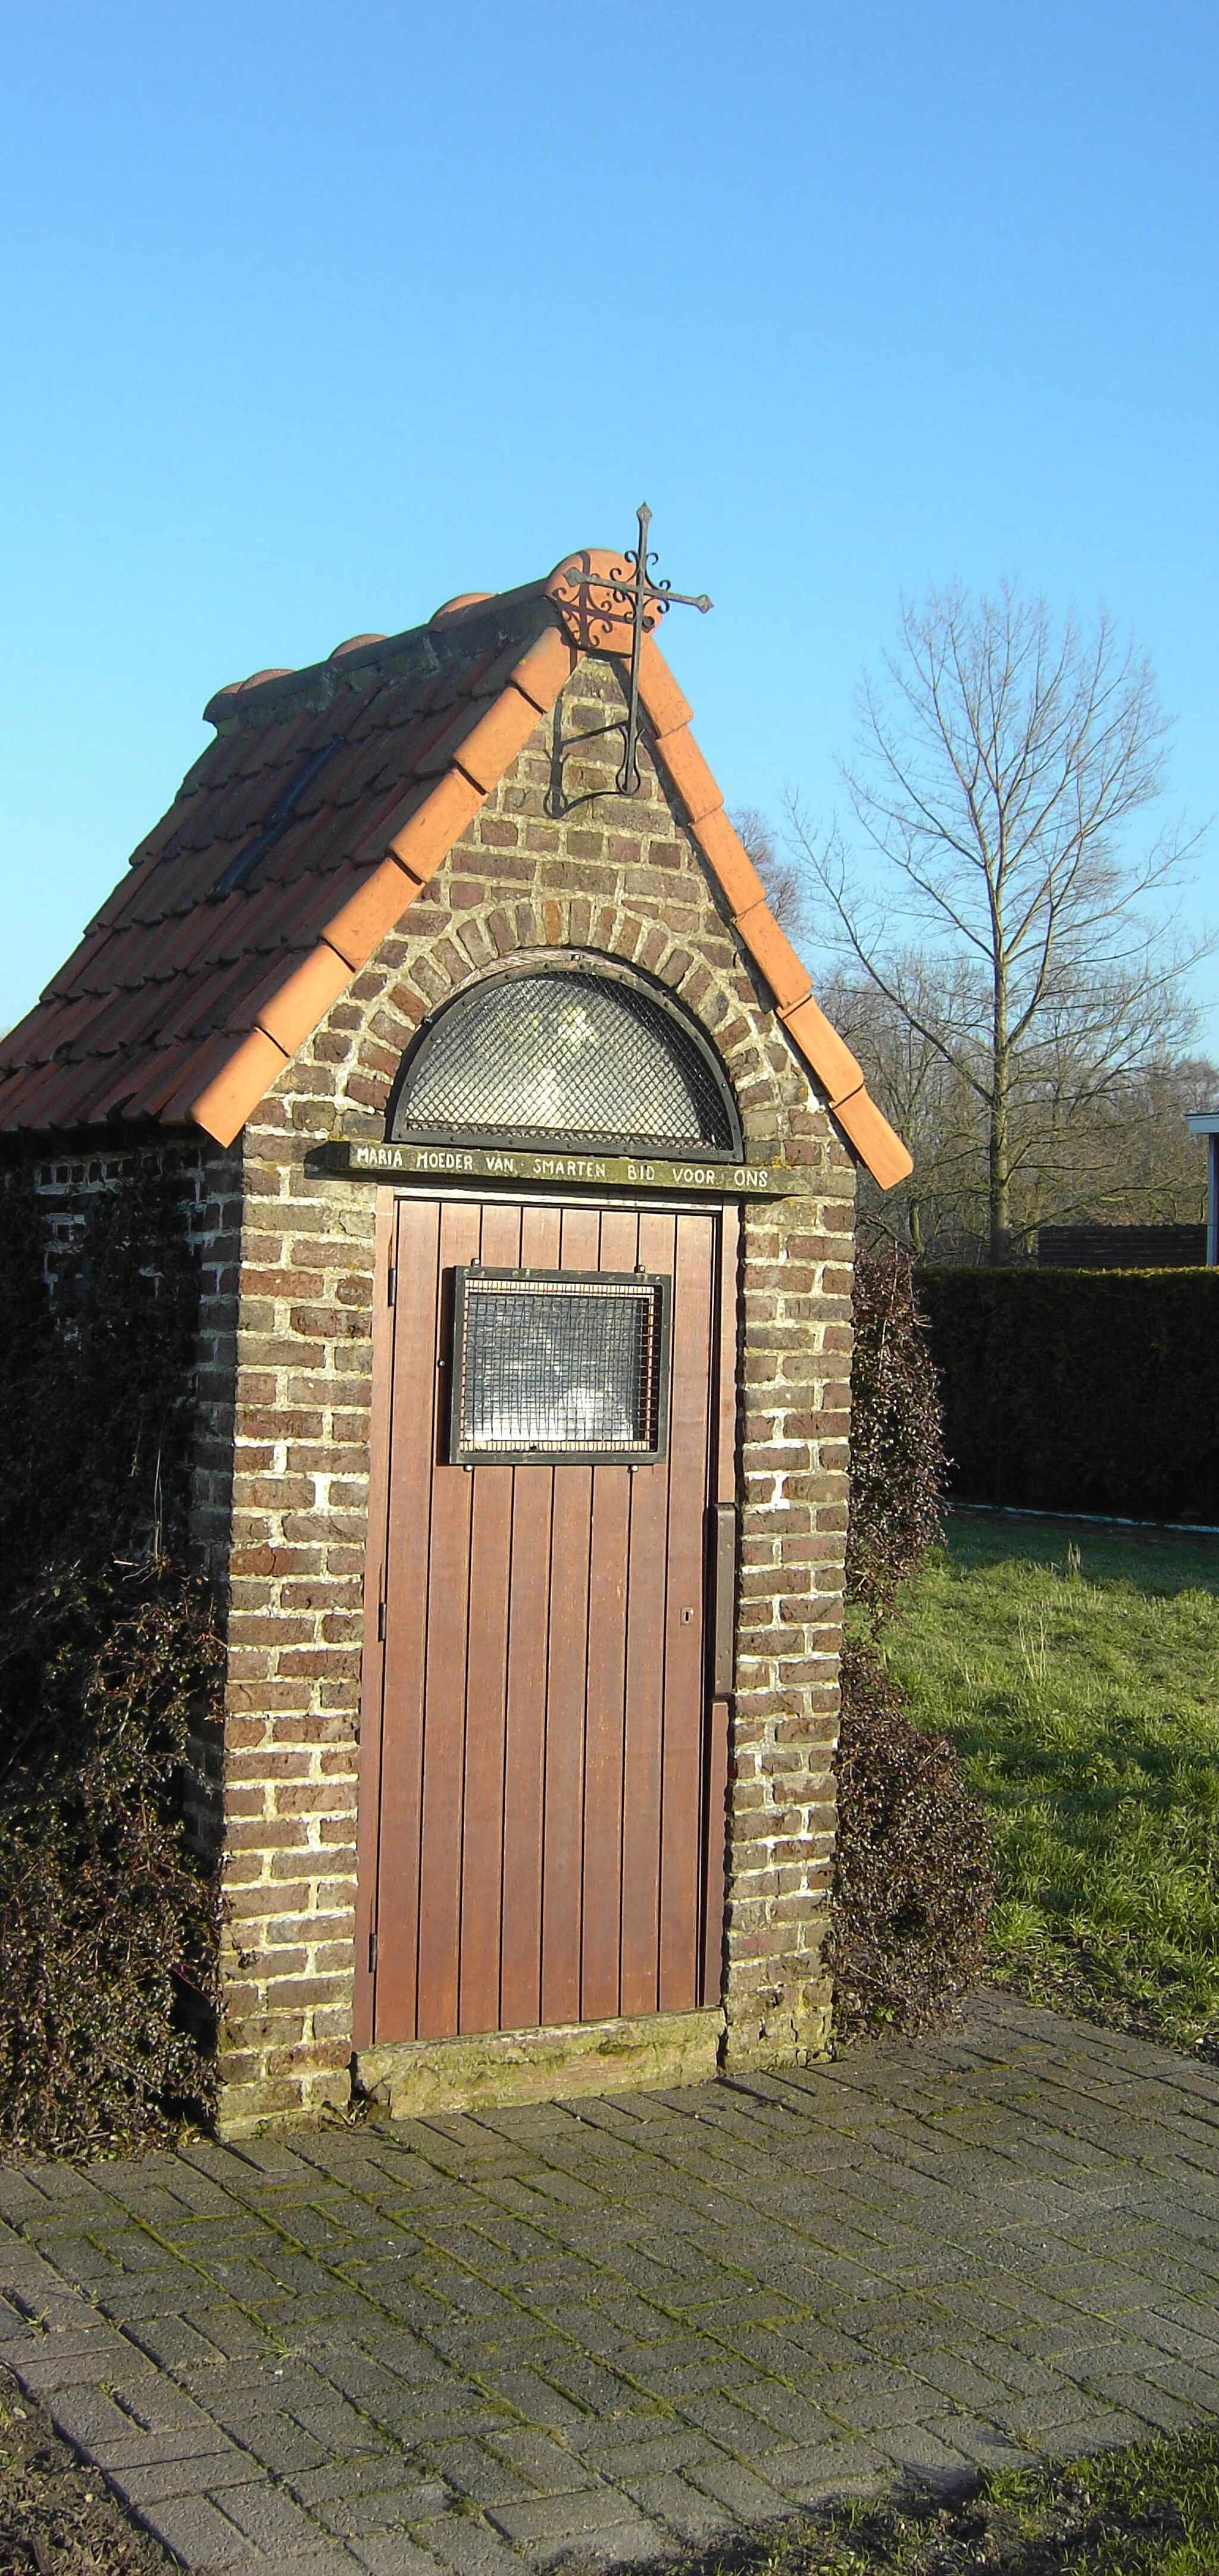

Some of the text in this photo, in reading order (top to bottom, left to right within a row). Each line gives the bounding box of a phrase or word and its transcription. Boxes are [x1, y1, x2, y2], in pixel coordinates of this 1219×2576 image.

[357, 1148, 402, 1166] MARIA
[417, 1152, 473, 1170] MOEDER
[533, 1159, 605, 1177] SMARTEN
[627, 1165, 655, 1181] BID
[673, 1169, 714, 1184] VOOR
[734, 1170, 768, 1188] ONS
